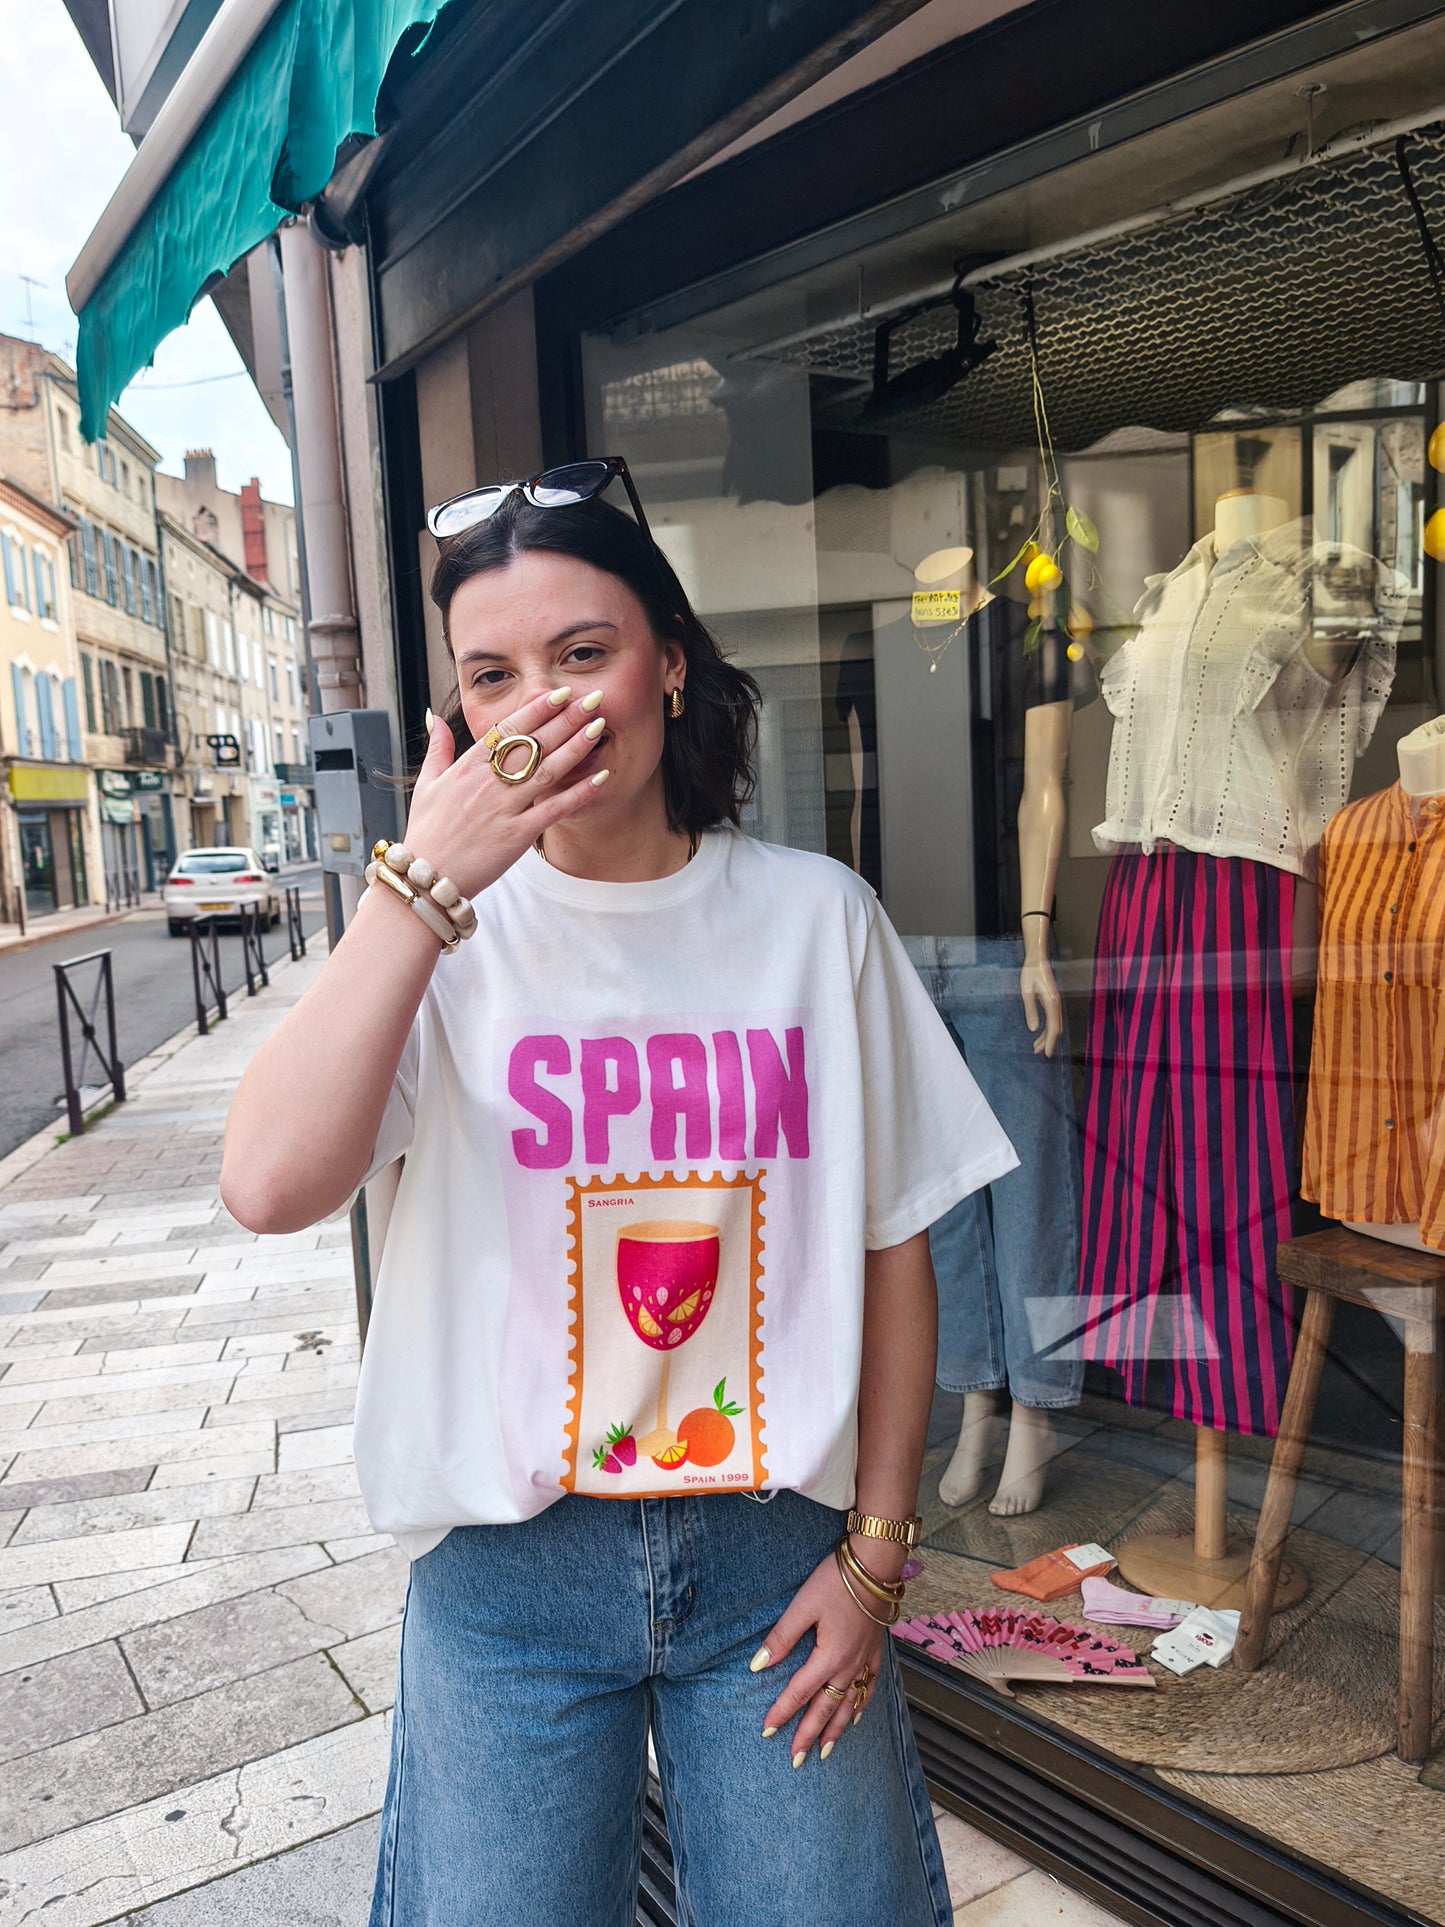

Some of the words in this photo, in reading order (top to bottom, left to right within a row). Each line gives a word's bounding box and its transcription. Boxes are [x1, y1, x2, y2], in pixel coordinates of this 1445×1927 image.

[508, 1026, 810, 1169] SPAIN
[588, 1198, 635, 1208] SANGRIA
[683, 1474, 716, 1484] SPAIN
[720, 1473, 749, 1483] 1999
